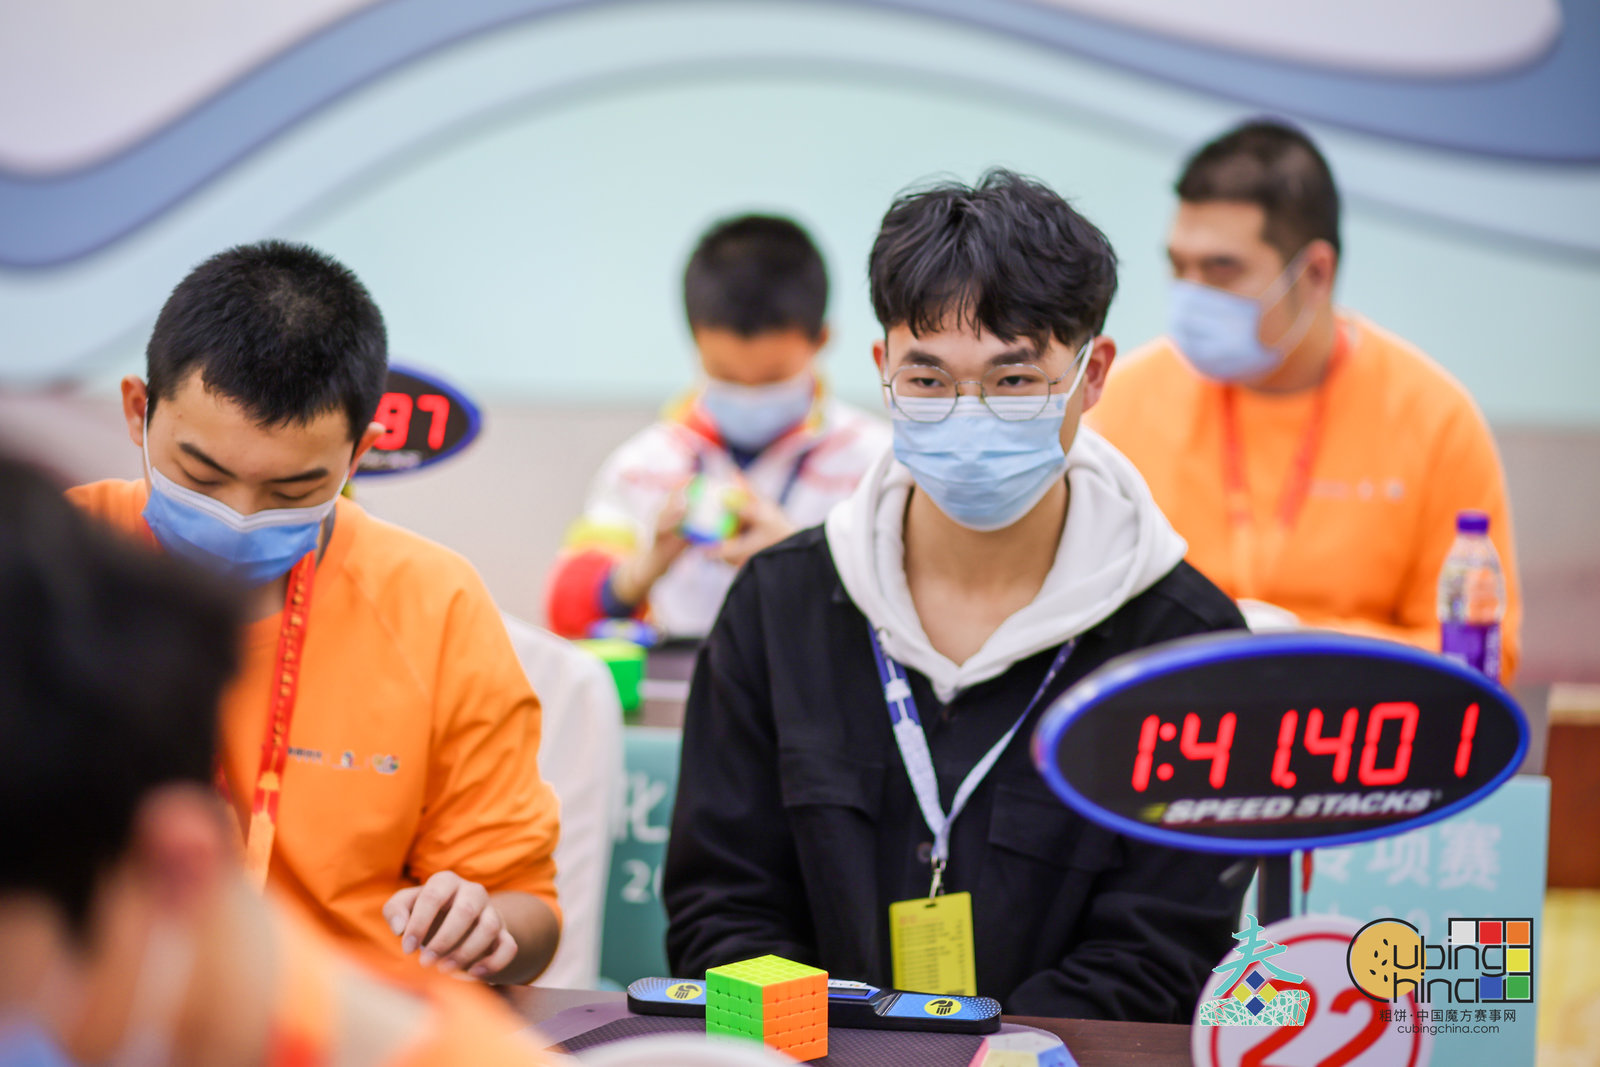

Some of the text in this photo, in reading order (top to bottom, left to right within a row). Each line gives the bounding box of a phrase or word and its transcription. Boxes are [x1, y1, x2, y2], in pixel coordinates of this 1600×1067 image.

[1131, 702, 1480, 792] 1:41.401
[1163, 790, 1433, 825] SPEED STACKS
[1239, 977, 1391, 1067] 22
